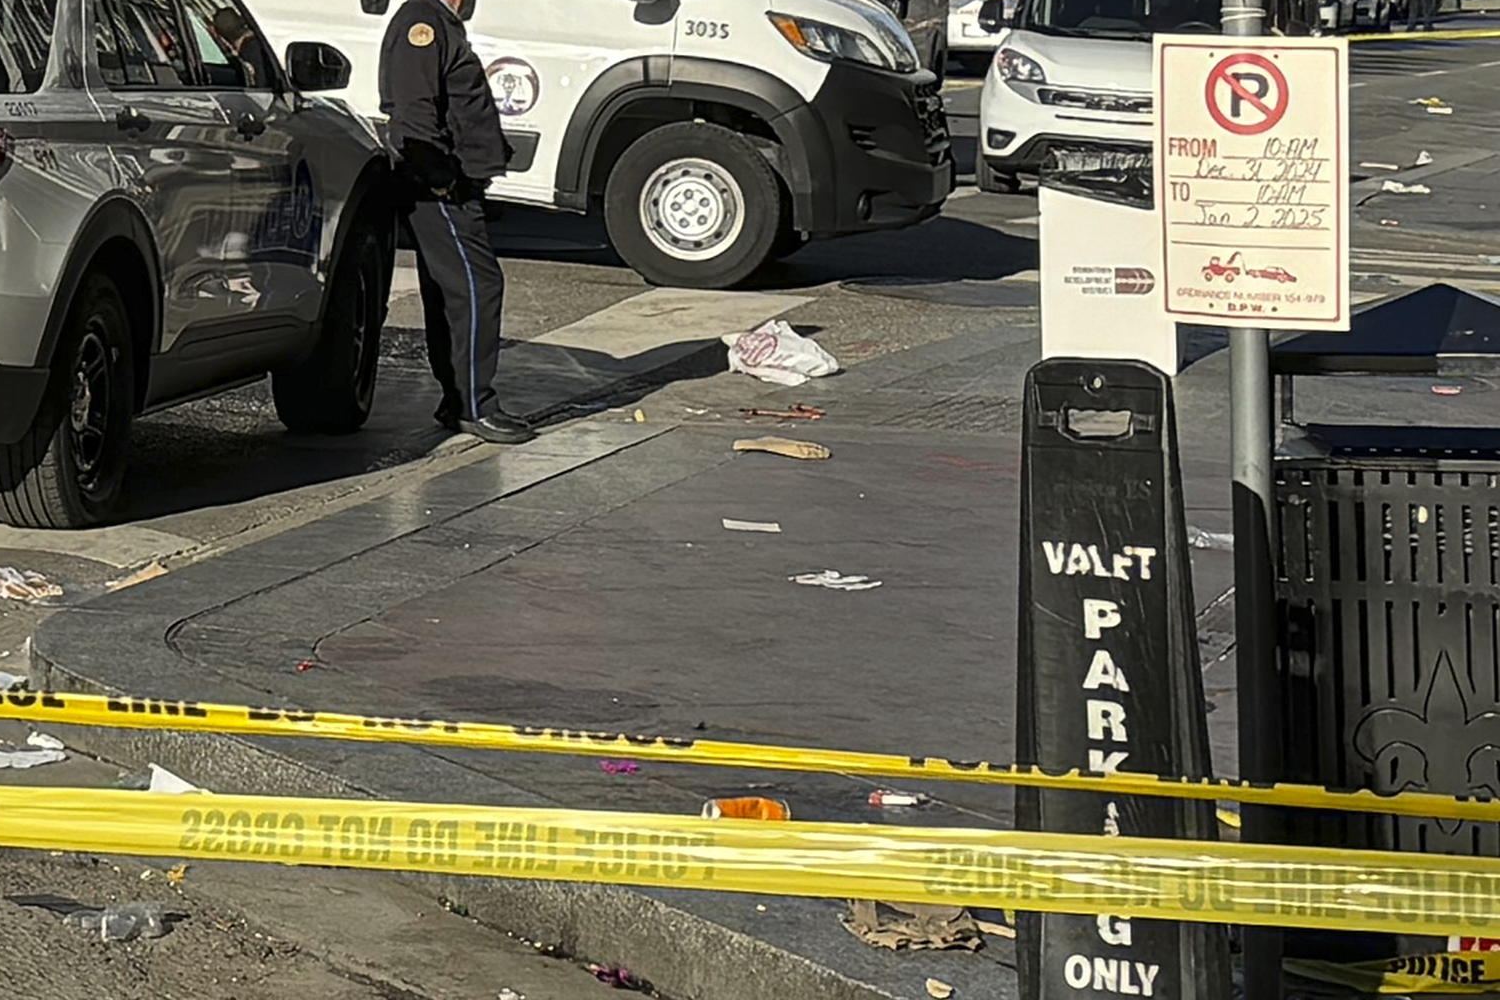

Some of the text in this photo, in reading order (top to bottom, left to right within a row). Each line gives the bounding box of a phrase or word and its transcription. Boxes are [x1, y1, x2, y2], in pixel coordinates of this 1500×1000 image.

[684, 20, 730, 39] 3035
[1168, 136, 1217, 159] FROM
[1170, 181, 1191, 203] TO
[1063, 953, 1160, 997] ONLY
[1384, 955, 1486, 985] POLICE
